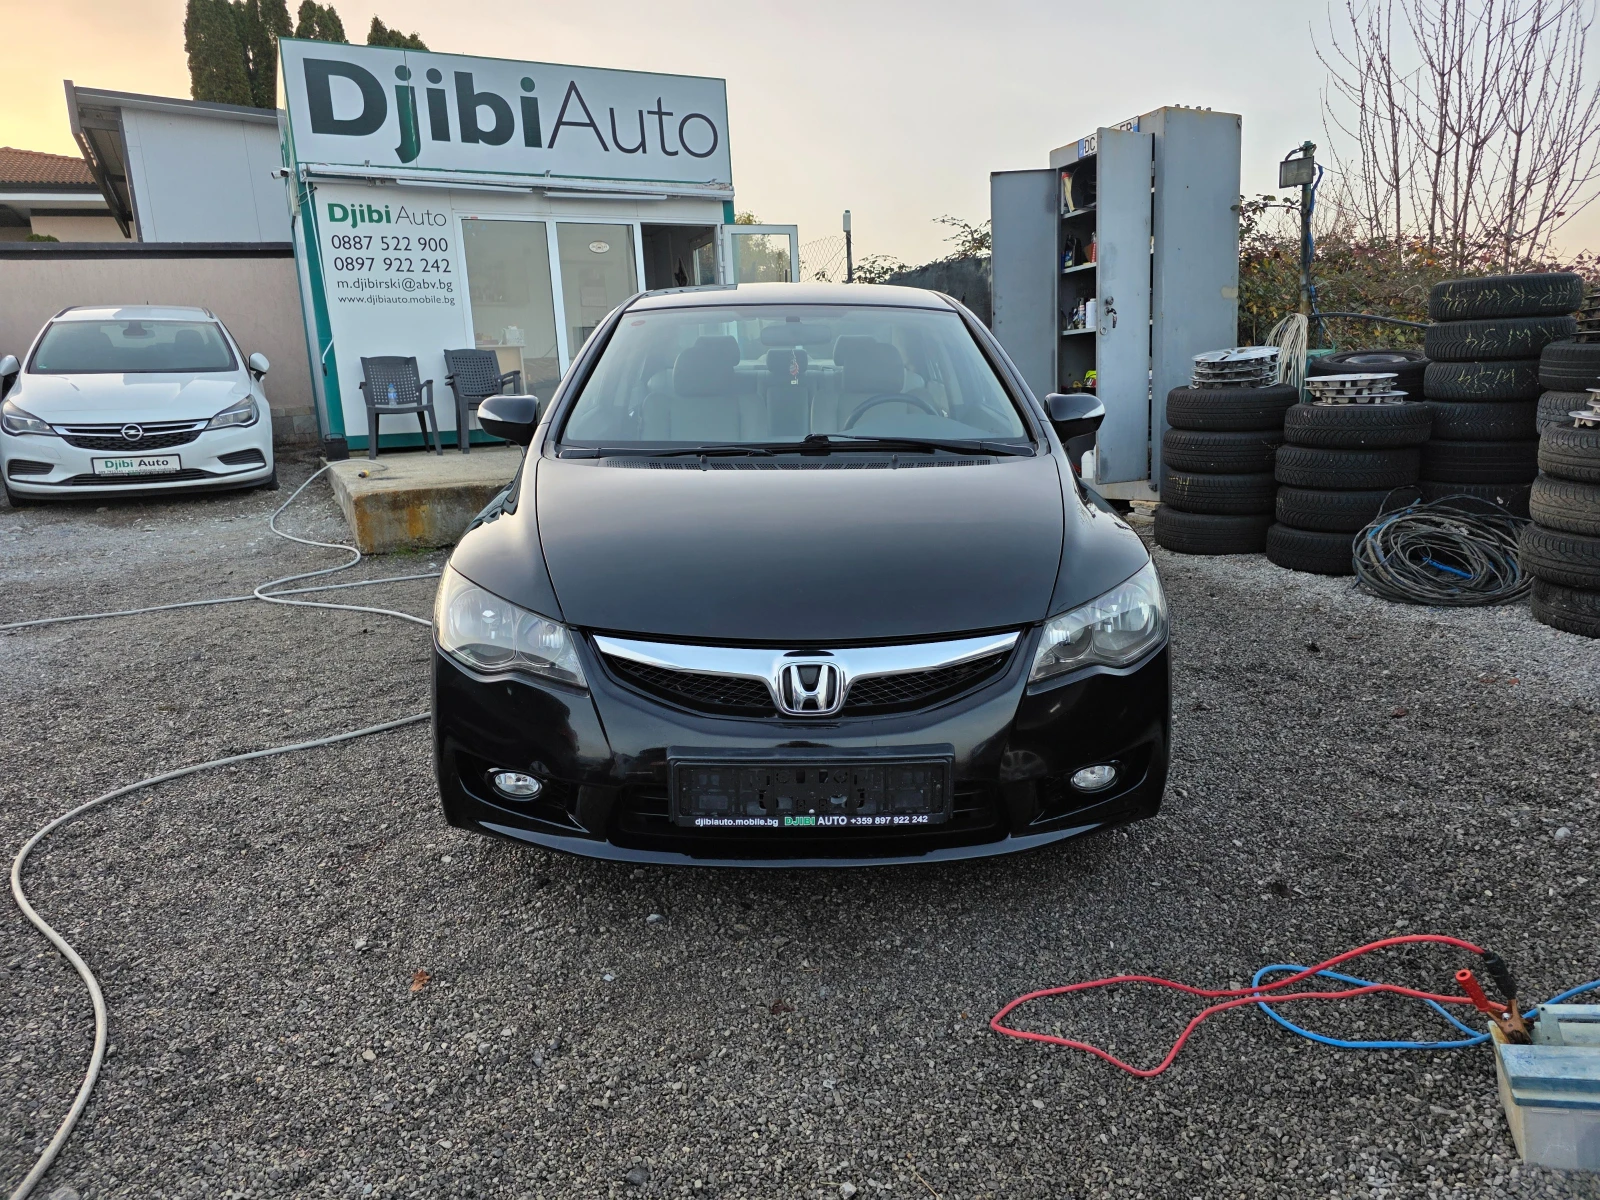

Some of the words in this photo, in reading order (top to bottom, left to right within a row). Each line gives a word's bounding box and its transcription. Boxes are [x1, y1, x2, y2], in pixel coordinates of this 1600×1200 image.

[327, 203, 392, 229] Djibi
[395, 205, 447, 227] Auto
[331, 234, 373, 250] 0887
[380, 235, 412, 251] 522
[417, 237, 448, 252] 900
[334, 256, 375, 272] 0897
[383, 257, 415, 273] 922
[420, 258, 452, 273] 242
[337, 277, 453, 293] m.djibirski@abv.bg
[337, 294, 456, 306] www.djibiauto.mobile.bg
[104, 459, 134, 470] Djibi
[138, 459, 169, 467] Auto
[695, 817, 779, 827] djibiauto.mobile.bg
[784, 816, 815, 826] DJIBI
[817, 816, 847, 825] AUTO
[850, 817, 873, 825] +359
[874, 816, 891, 824] 897
[893, 815, 909, 824] 922
[911, 815, 928, 823] 242
